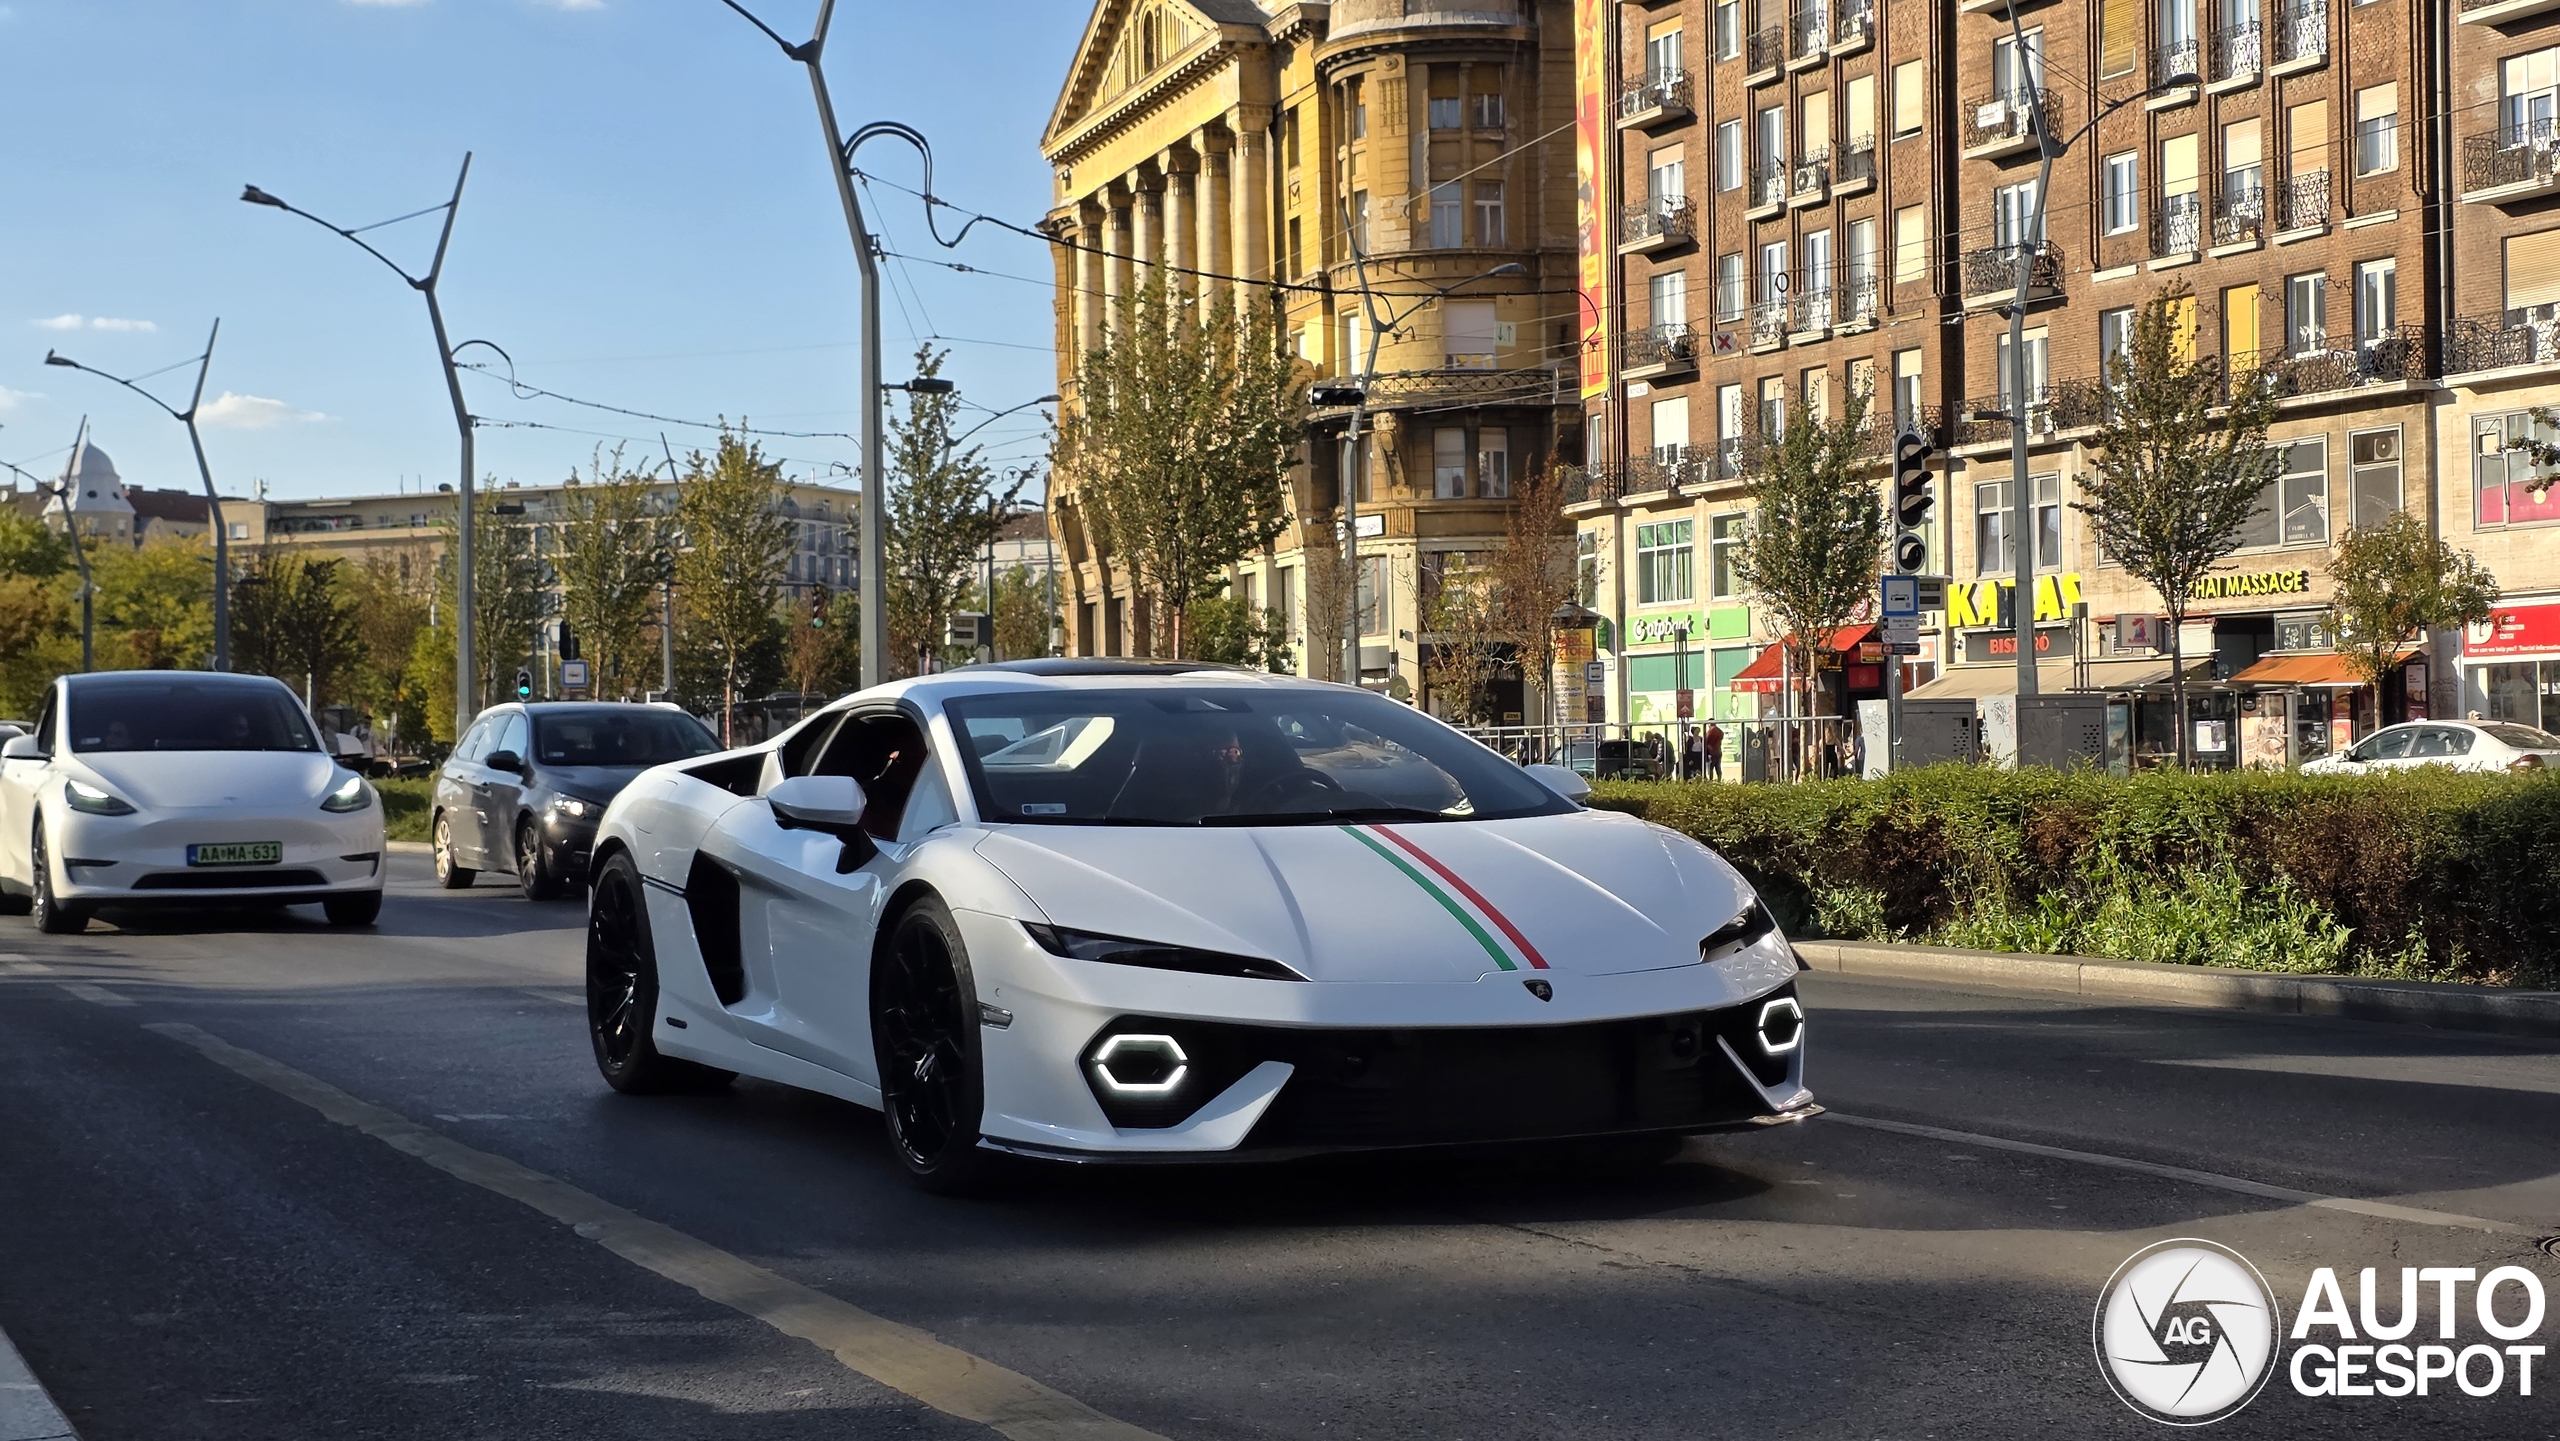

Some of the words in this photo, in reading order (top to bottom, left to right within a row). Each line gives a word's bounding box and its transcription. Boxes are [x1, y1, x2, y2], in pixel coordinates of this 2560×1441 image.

[1907, 423, 1915, 432] A
[2226, 569, 2303, 596] MASSAGE
[1862, 645, 1882, 654] chang
[1990, 631, 2050, 654] BISZÓ
